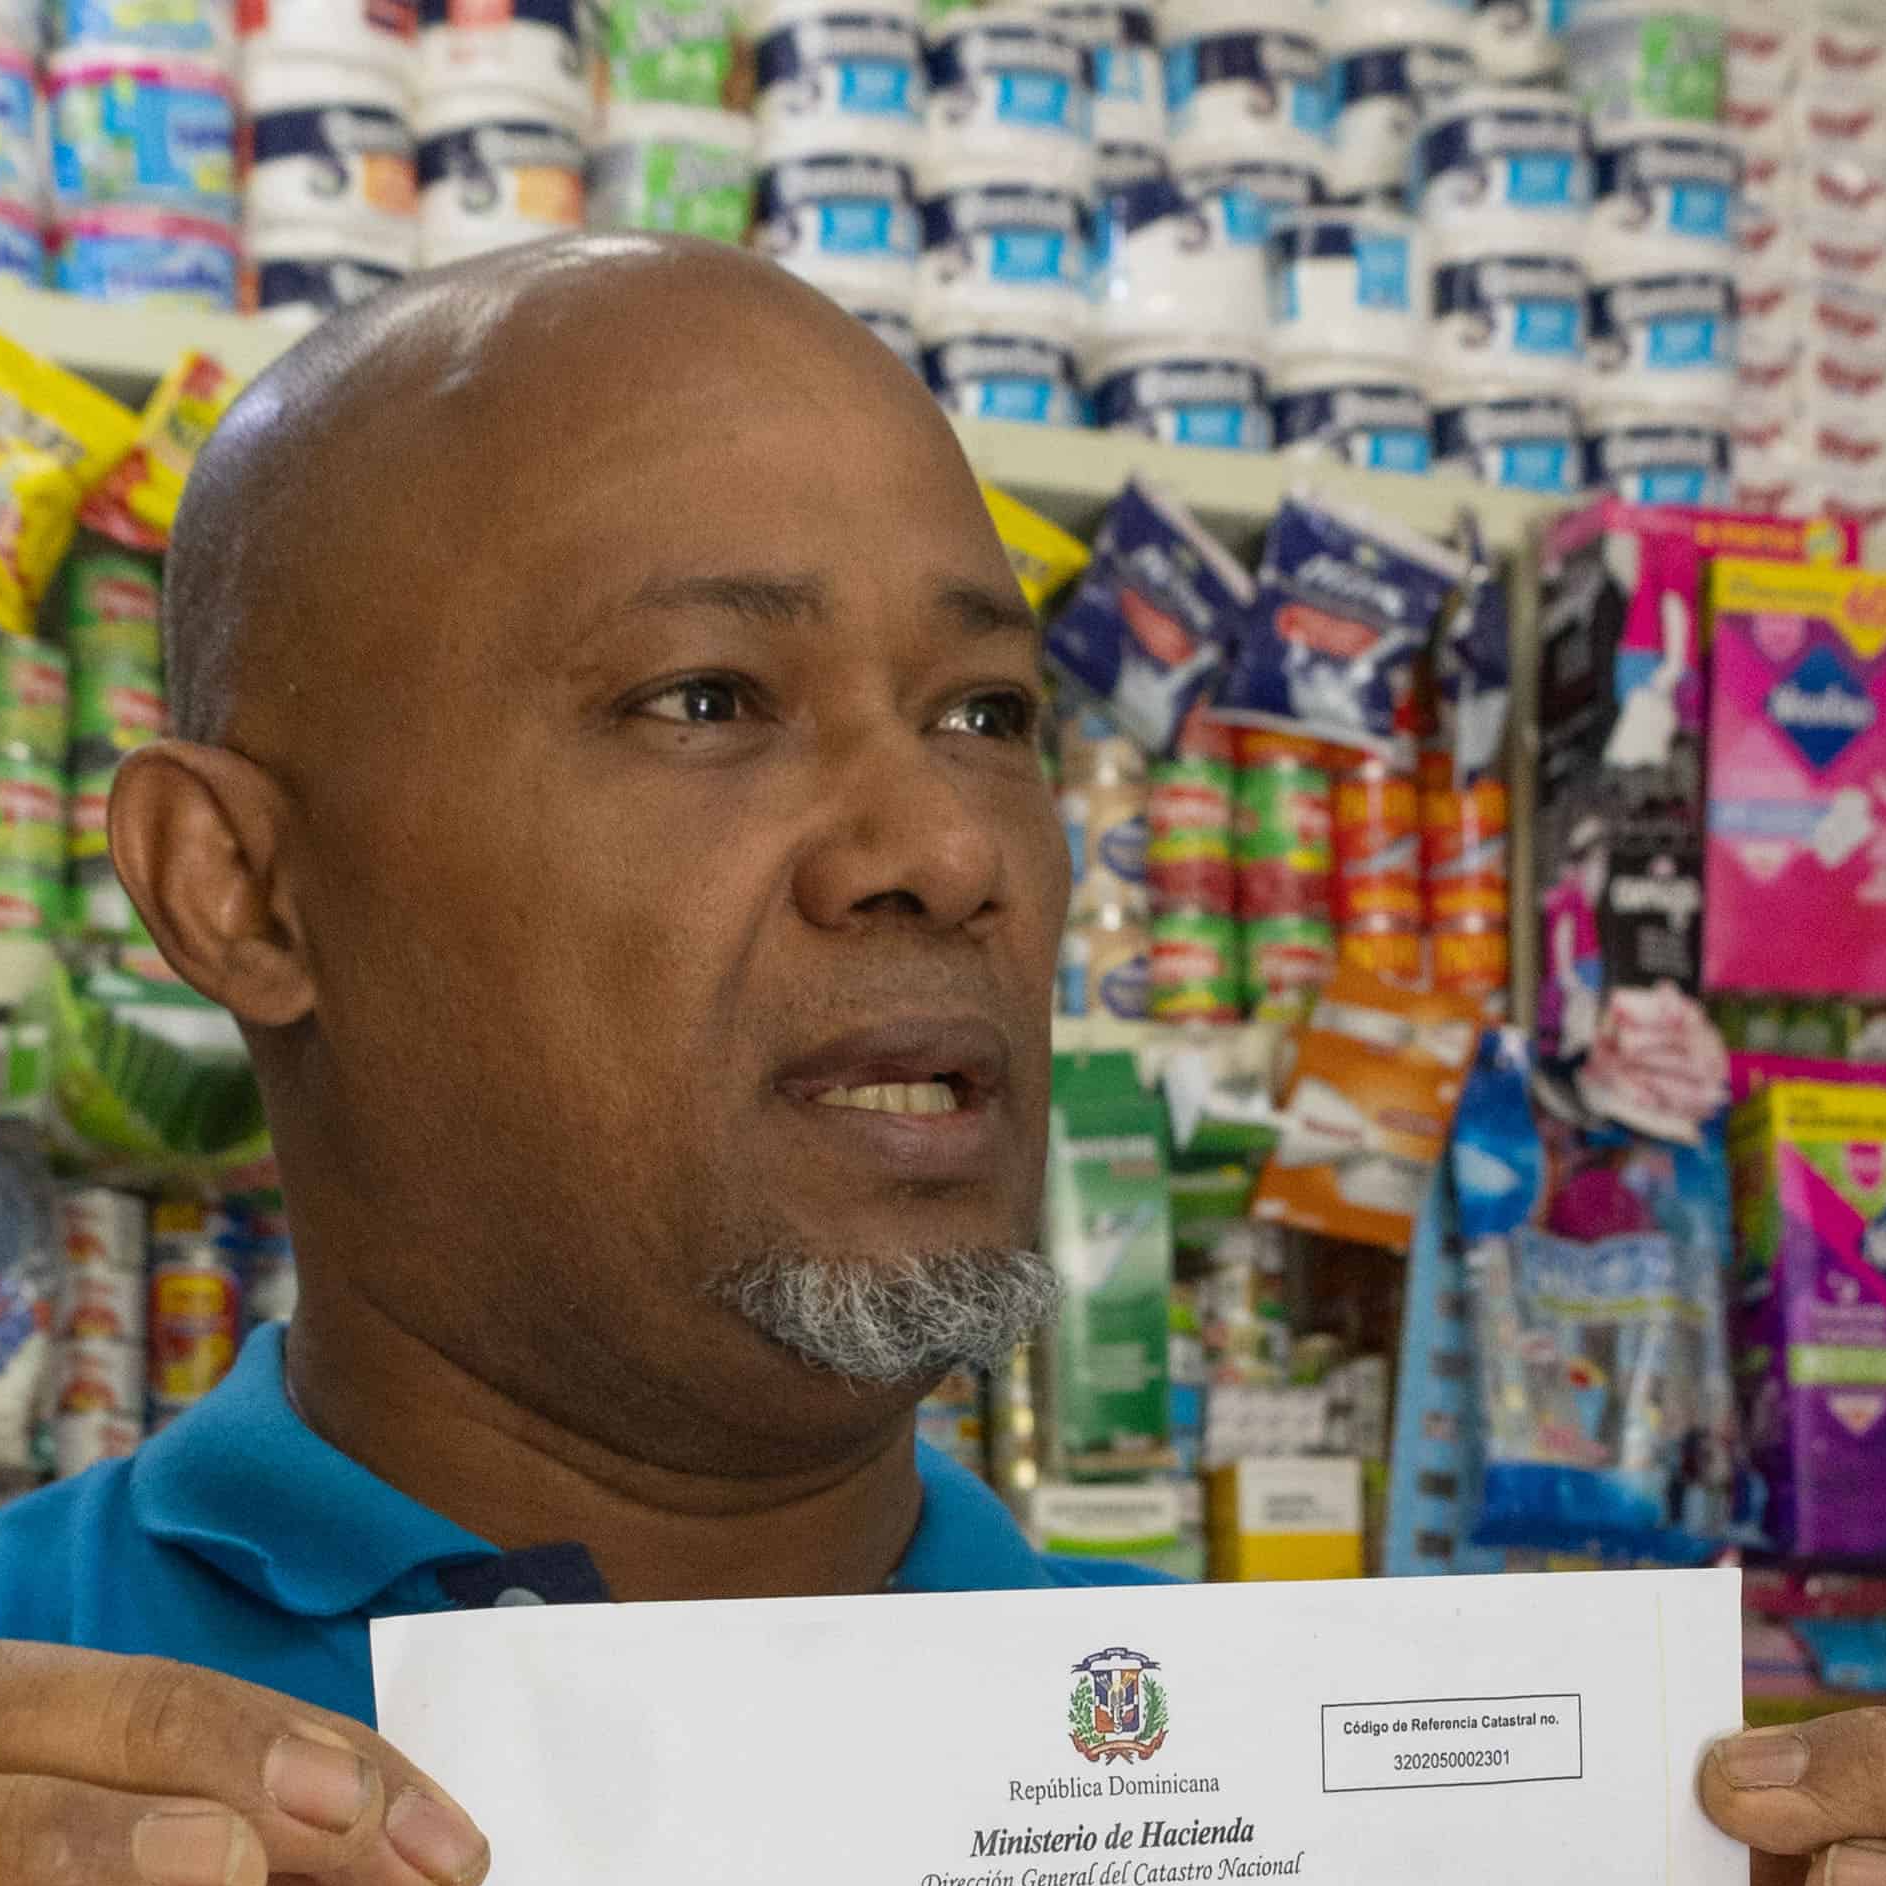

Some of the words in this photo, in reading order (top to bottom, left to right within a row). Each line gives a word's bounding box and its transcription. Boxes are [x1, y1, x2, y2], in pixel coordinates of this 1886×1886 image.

[1343, 1720, 1388, 1736] Código
[1392, 1719, 1407, 1732] de
[1411, 1715, 1477, 1731] Referencia
[1481, 1712, 1536, 1728] Catastral
[1540, 1714, 1558, 1725] no.
[1393, 1748, 1509, 1770] 3202050002301
[1009, 1776, 1102, 1805] República
[1108, 1772, 1219, 1795] Dominicana
[969, 1823, 1097, 1857] Ministerio
[1104, 1822, 1133, 1849] de
[1138, 1816, 1254, 1848] Hacienda
[1099, 1861, 1131, 1886] del
[1133, 1861, 1213, 1886] Catastro
[1217, 1850, 1304, 1880] Nacional
